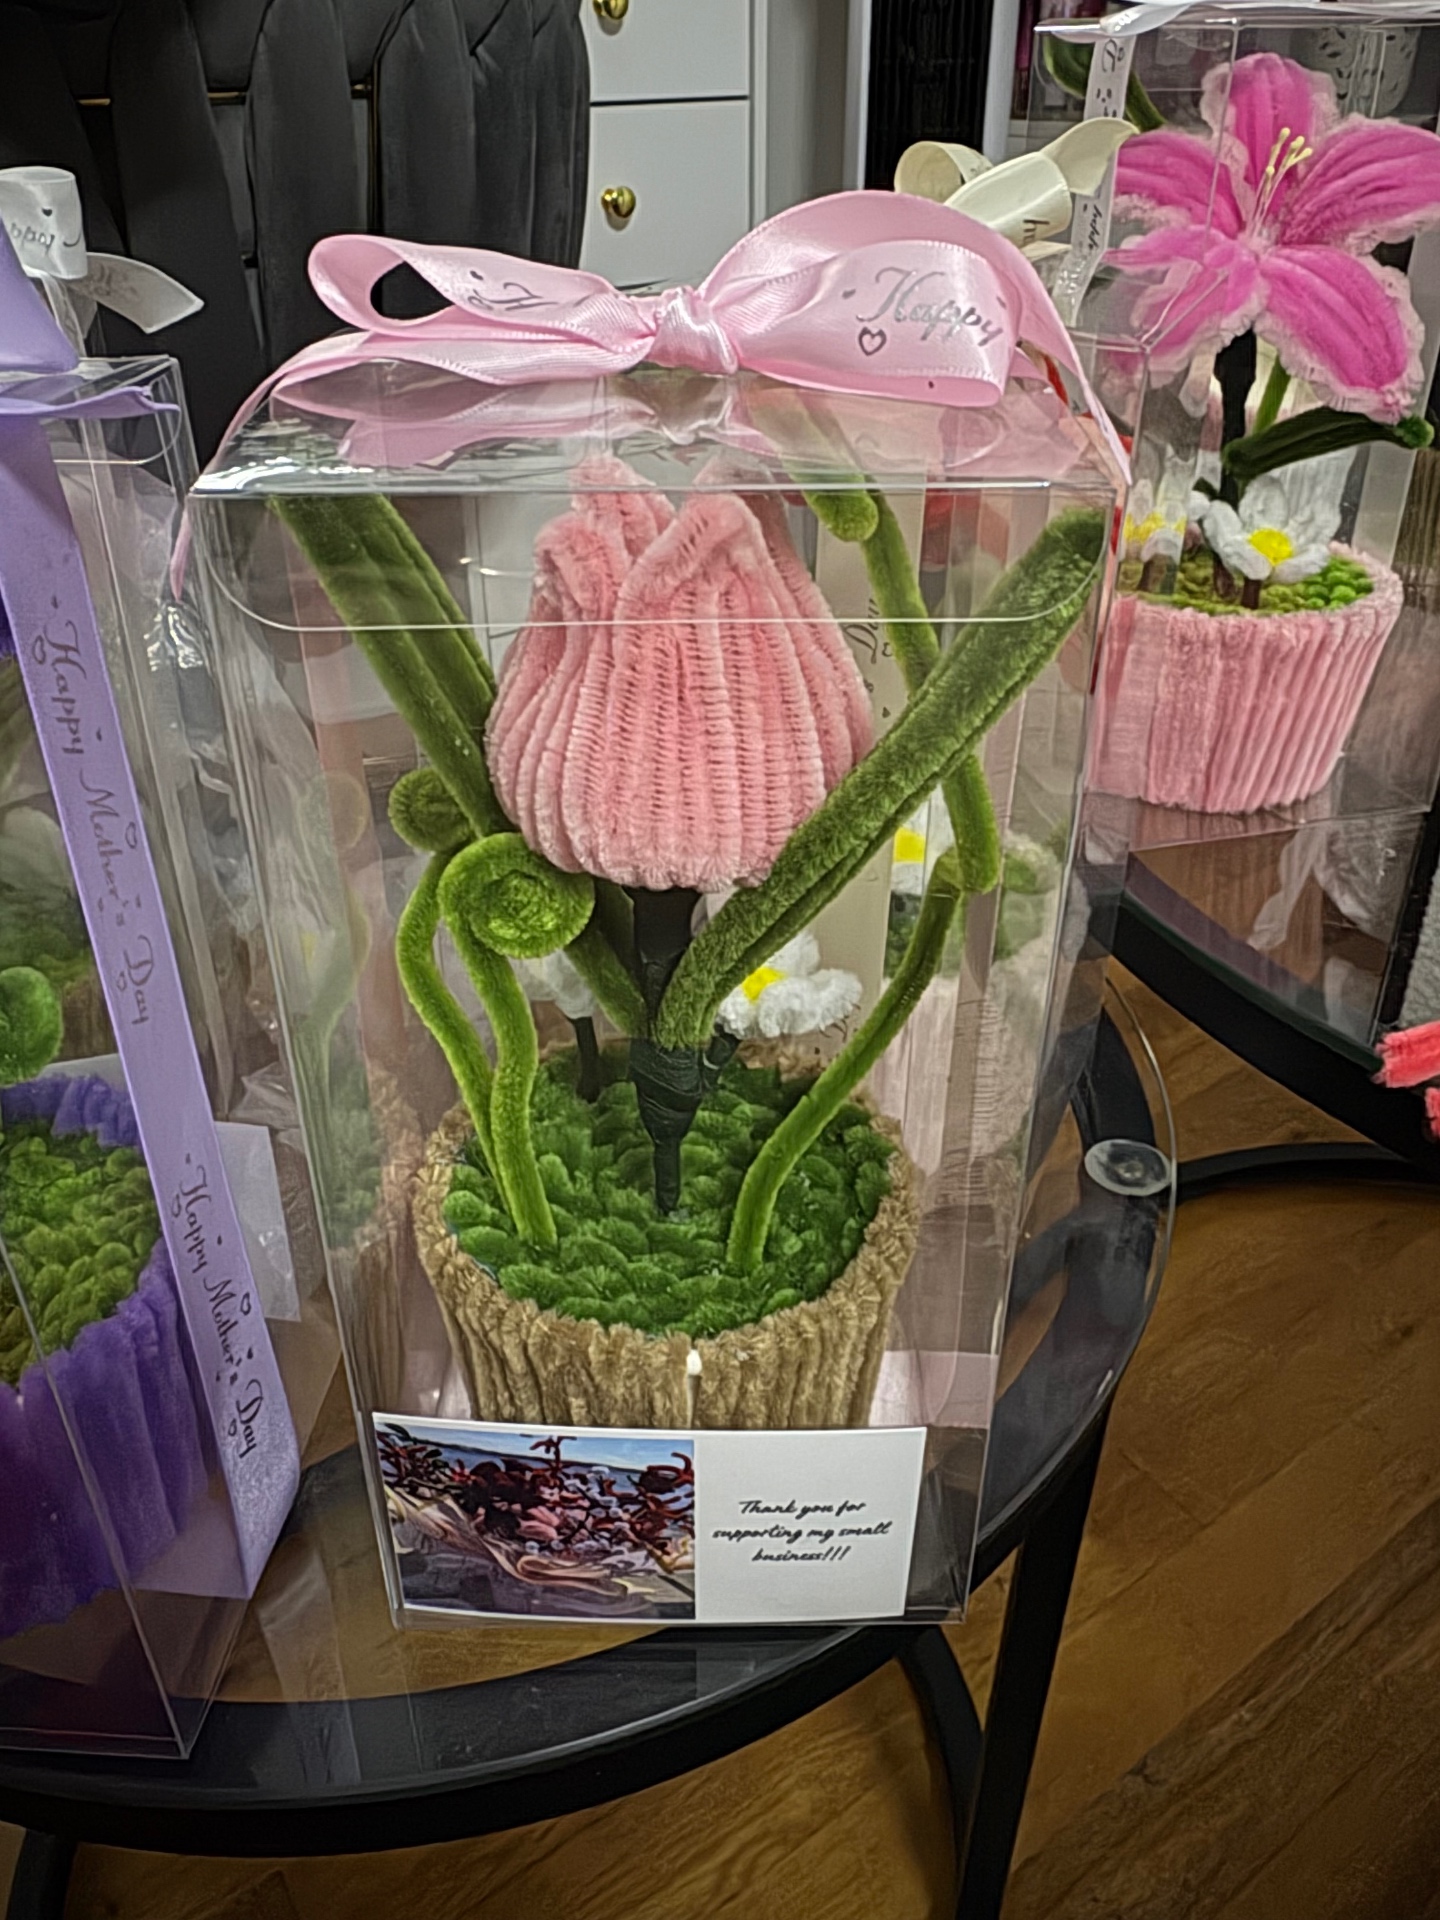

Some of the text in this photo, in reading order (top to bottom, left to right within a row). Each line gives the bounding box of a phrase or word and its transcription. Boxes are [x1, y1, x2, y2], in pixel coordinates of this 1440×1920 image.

[856, 266, 1004, 347] Happy
[44, 620, 155, 1025] Happy Mother's Day
[178, 1166, 265, 1460] Happy Mother's Day
[712, 1521, 893, 1544] supporting my small
[739, 1500, 866, 1520] Thank you for
[752, 1546, 851, 1562] business!!!
